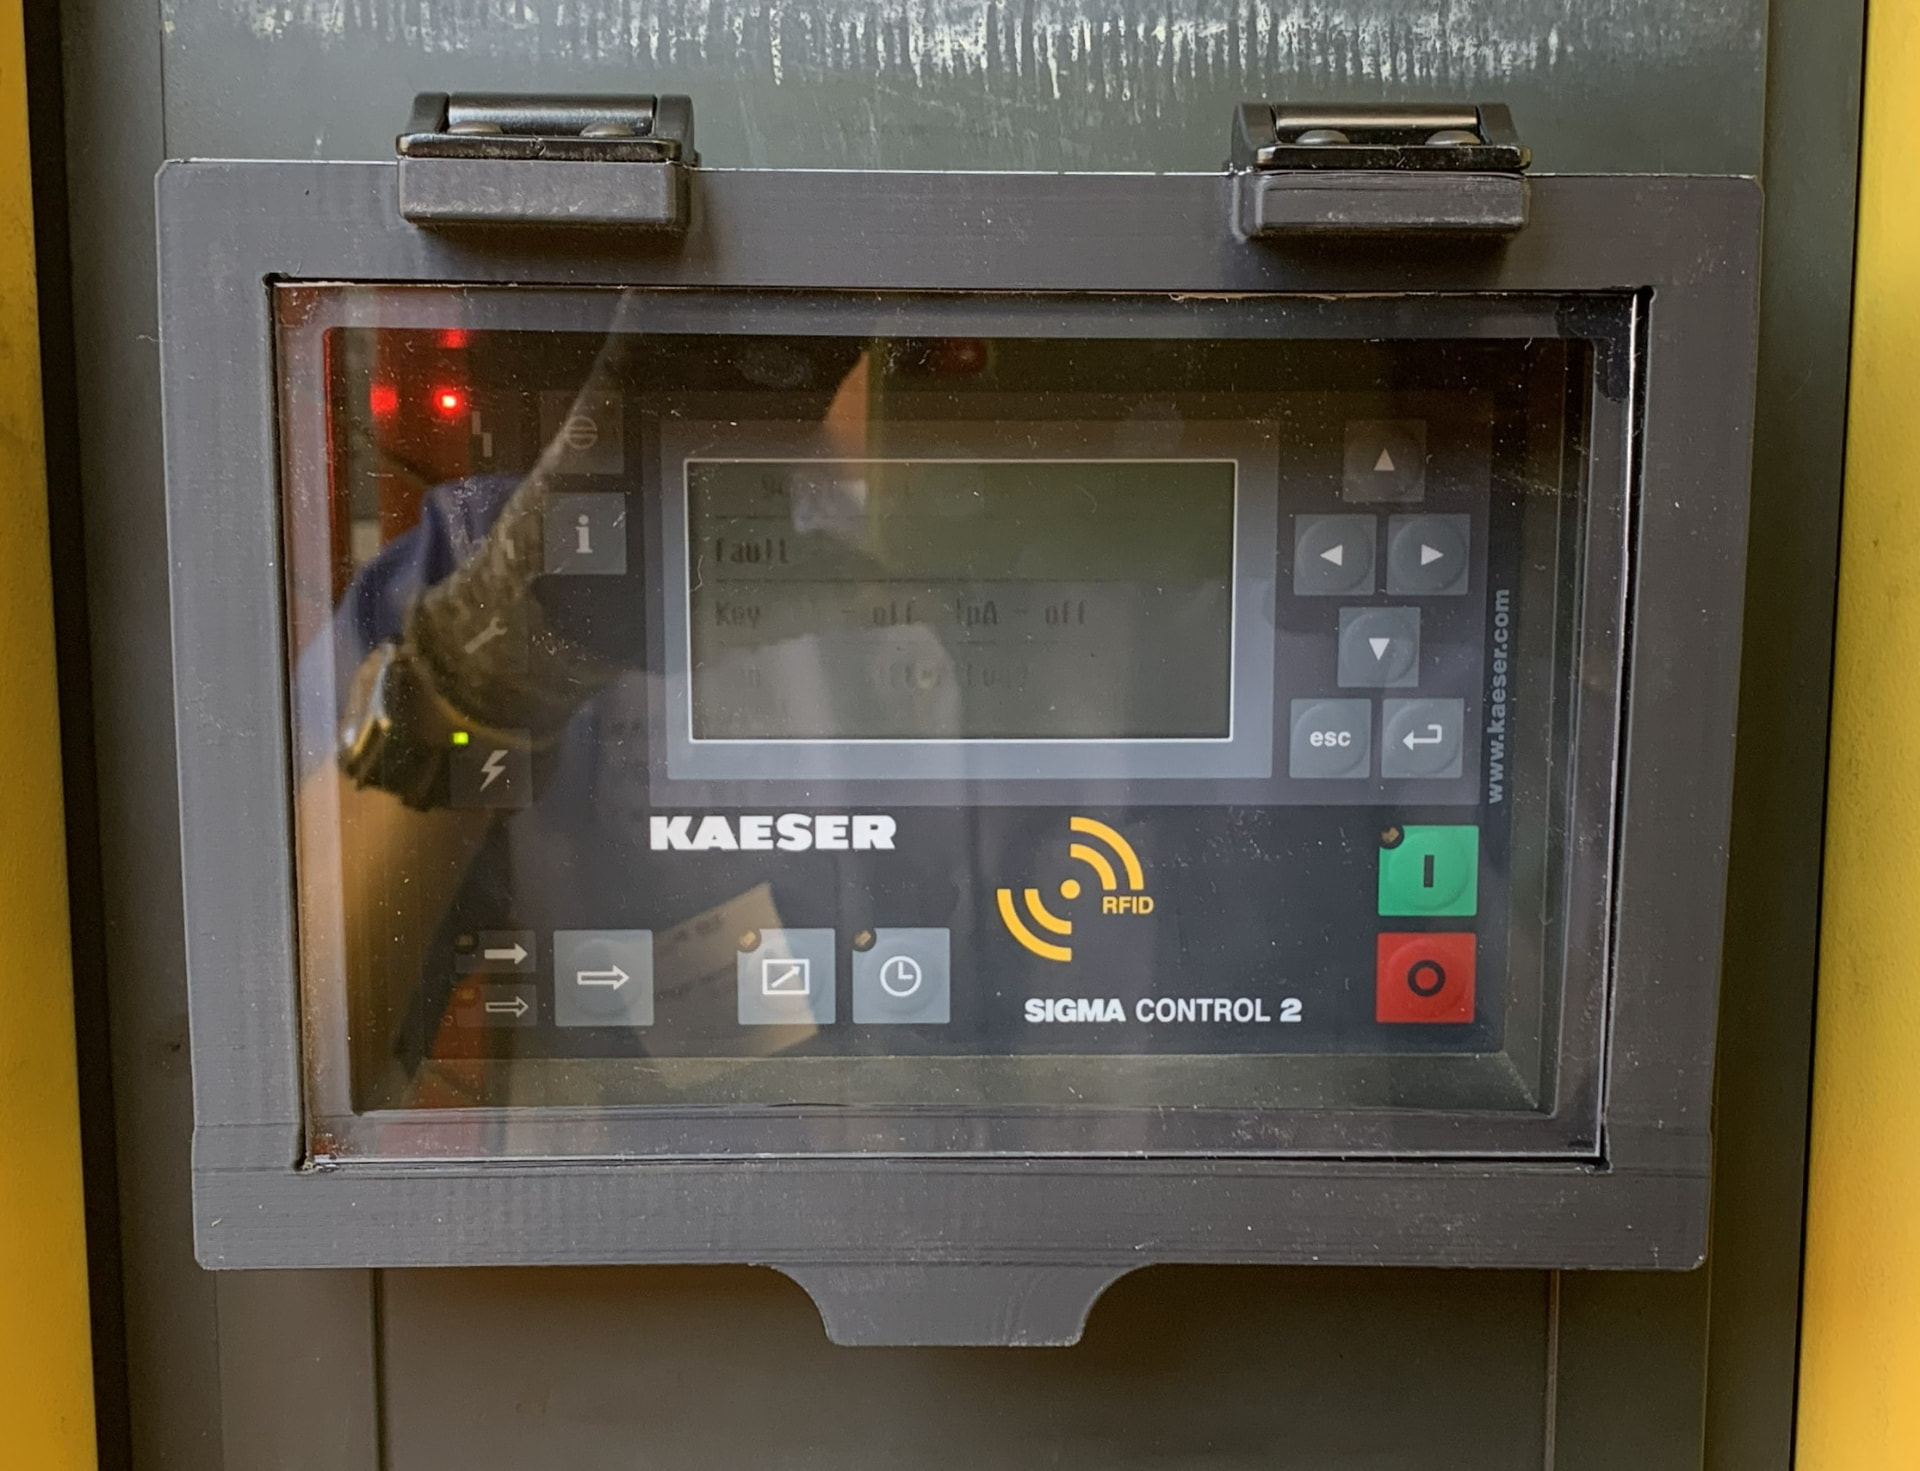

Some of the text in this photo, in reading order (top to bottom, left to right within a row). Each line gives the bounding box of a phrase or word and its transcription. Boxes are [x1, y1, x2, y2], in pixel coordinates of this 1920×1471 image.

[715, 601, 760, 629] Key
[1487, 589, 1510, 804] www.kaeser.com
[1309, 730, 1351, 747] esc
[650, 813, 897, 851] KAESER
[1102, 896, 1154, 914] RFID
[1024, 998, 1303, 1022] SIGMA CONTROL 2
